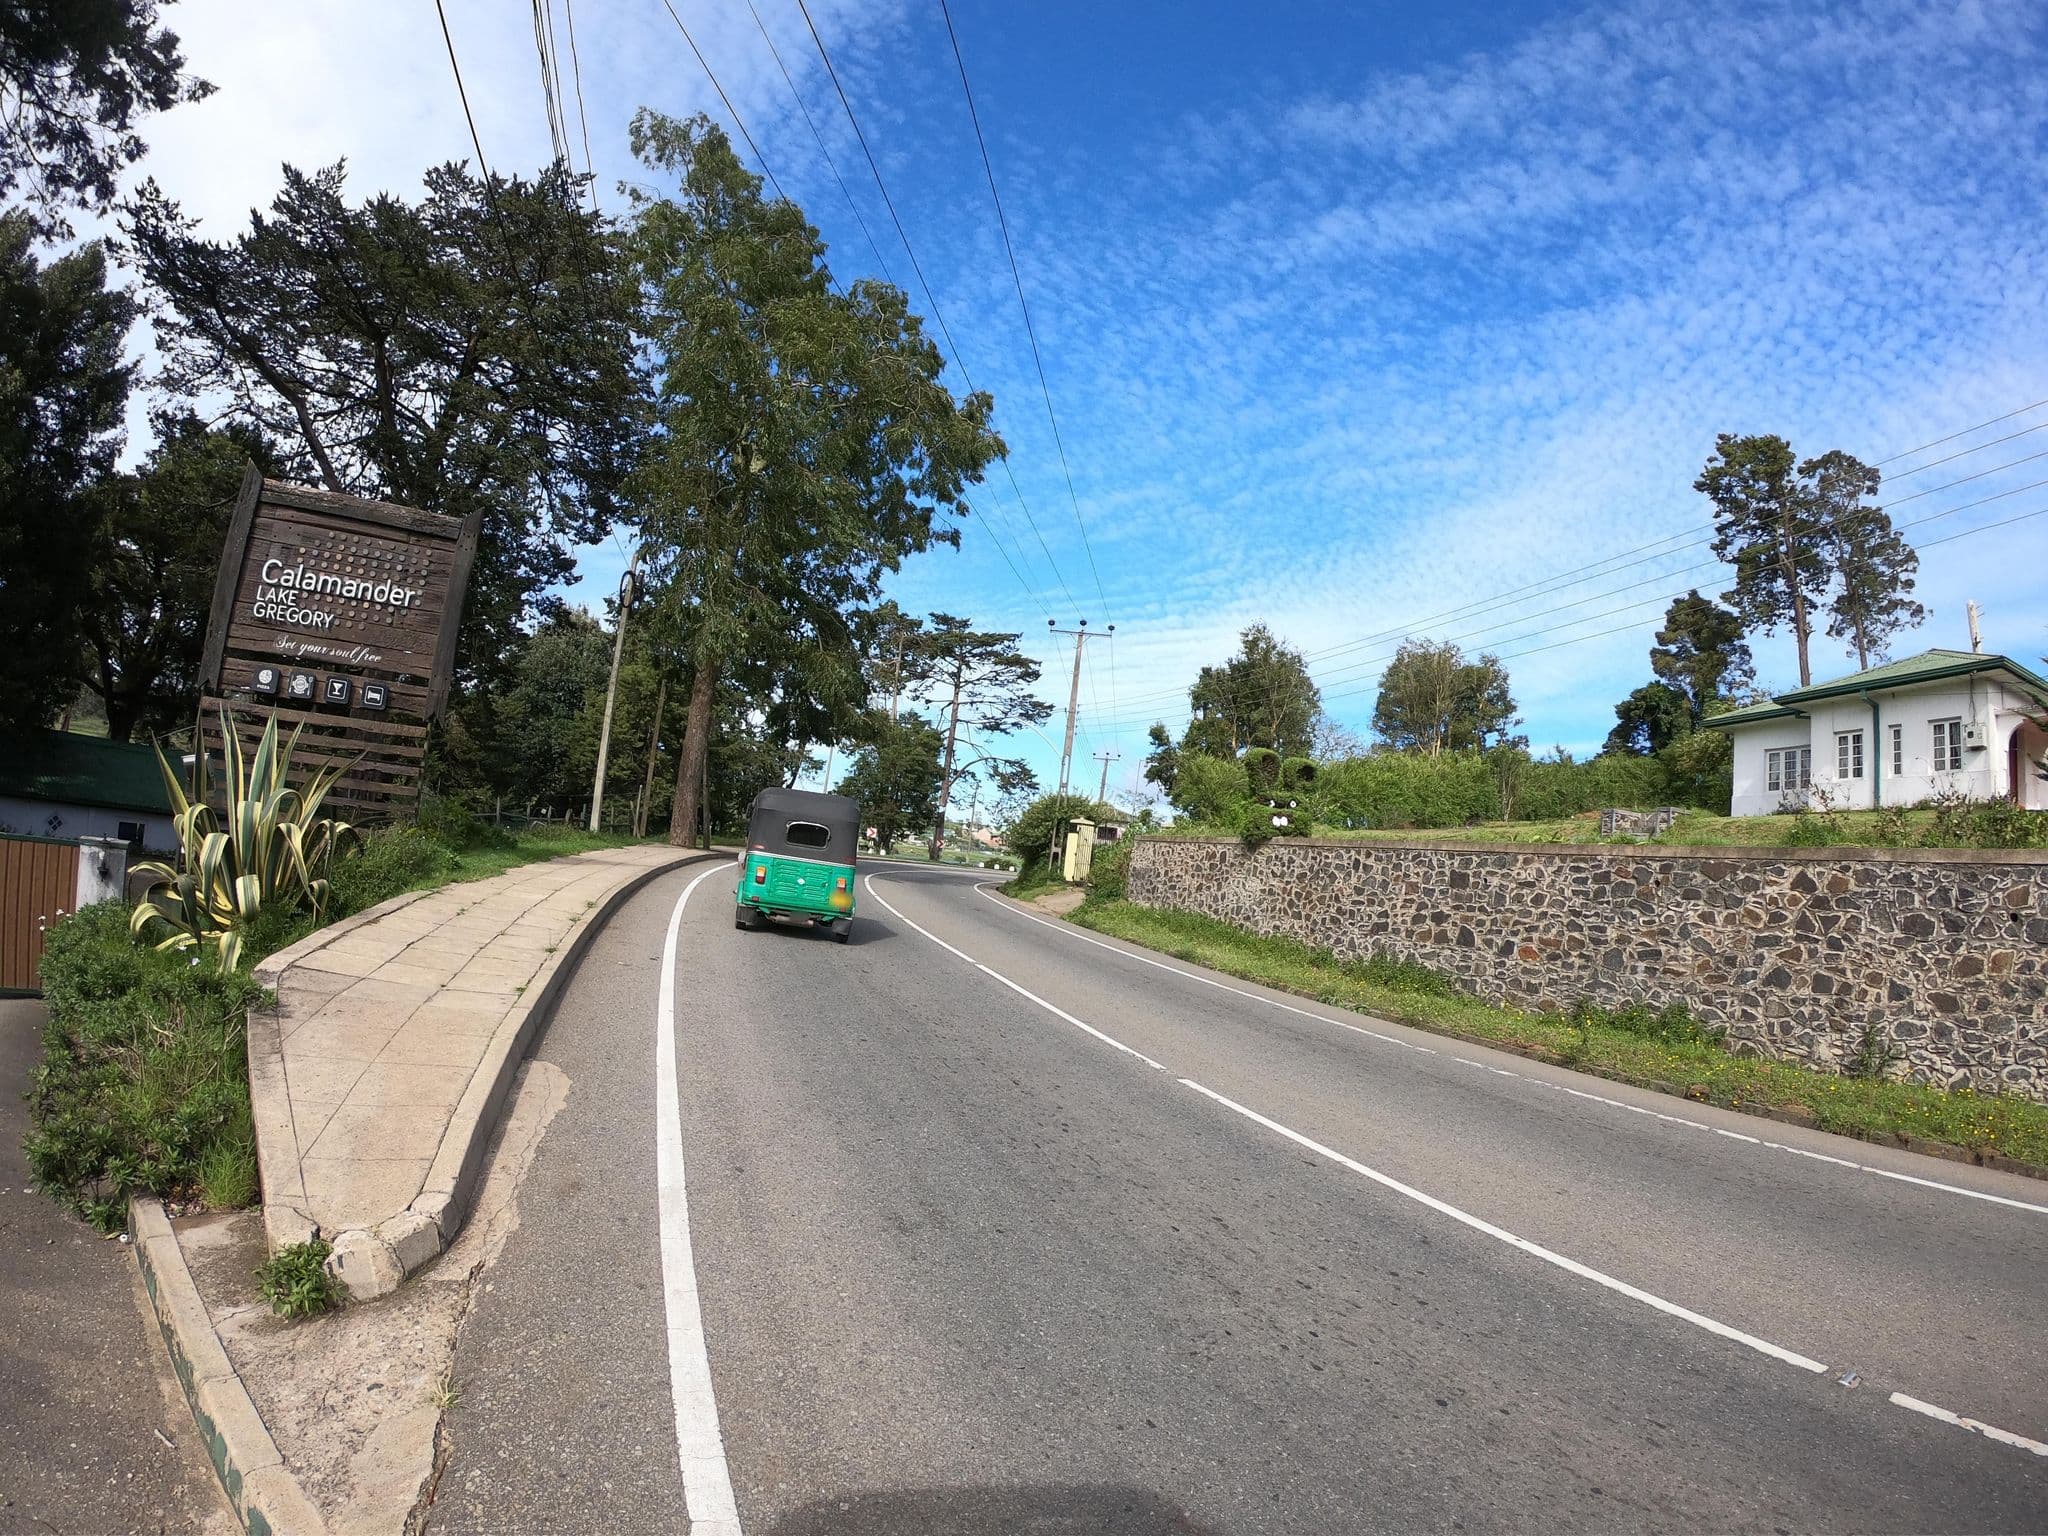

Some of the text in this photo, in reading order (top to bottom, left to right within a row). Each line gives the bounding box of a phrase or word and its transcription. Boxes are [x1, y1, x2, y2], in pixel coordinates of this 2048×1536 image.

[256, 585, 299, 606] LAKE
[262, 559, 416, 606] Calamander
[253, 602, 334, 628] GREGORY
[276, 635, 382, 664] Set your soul free
